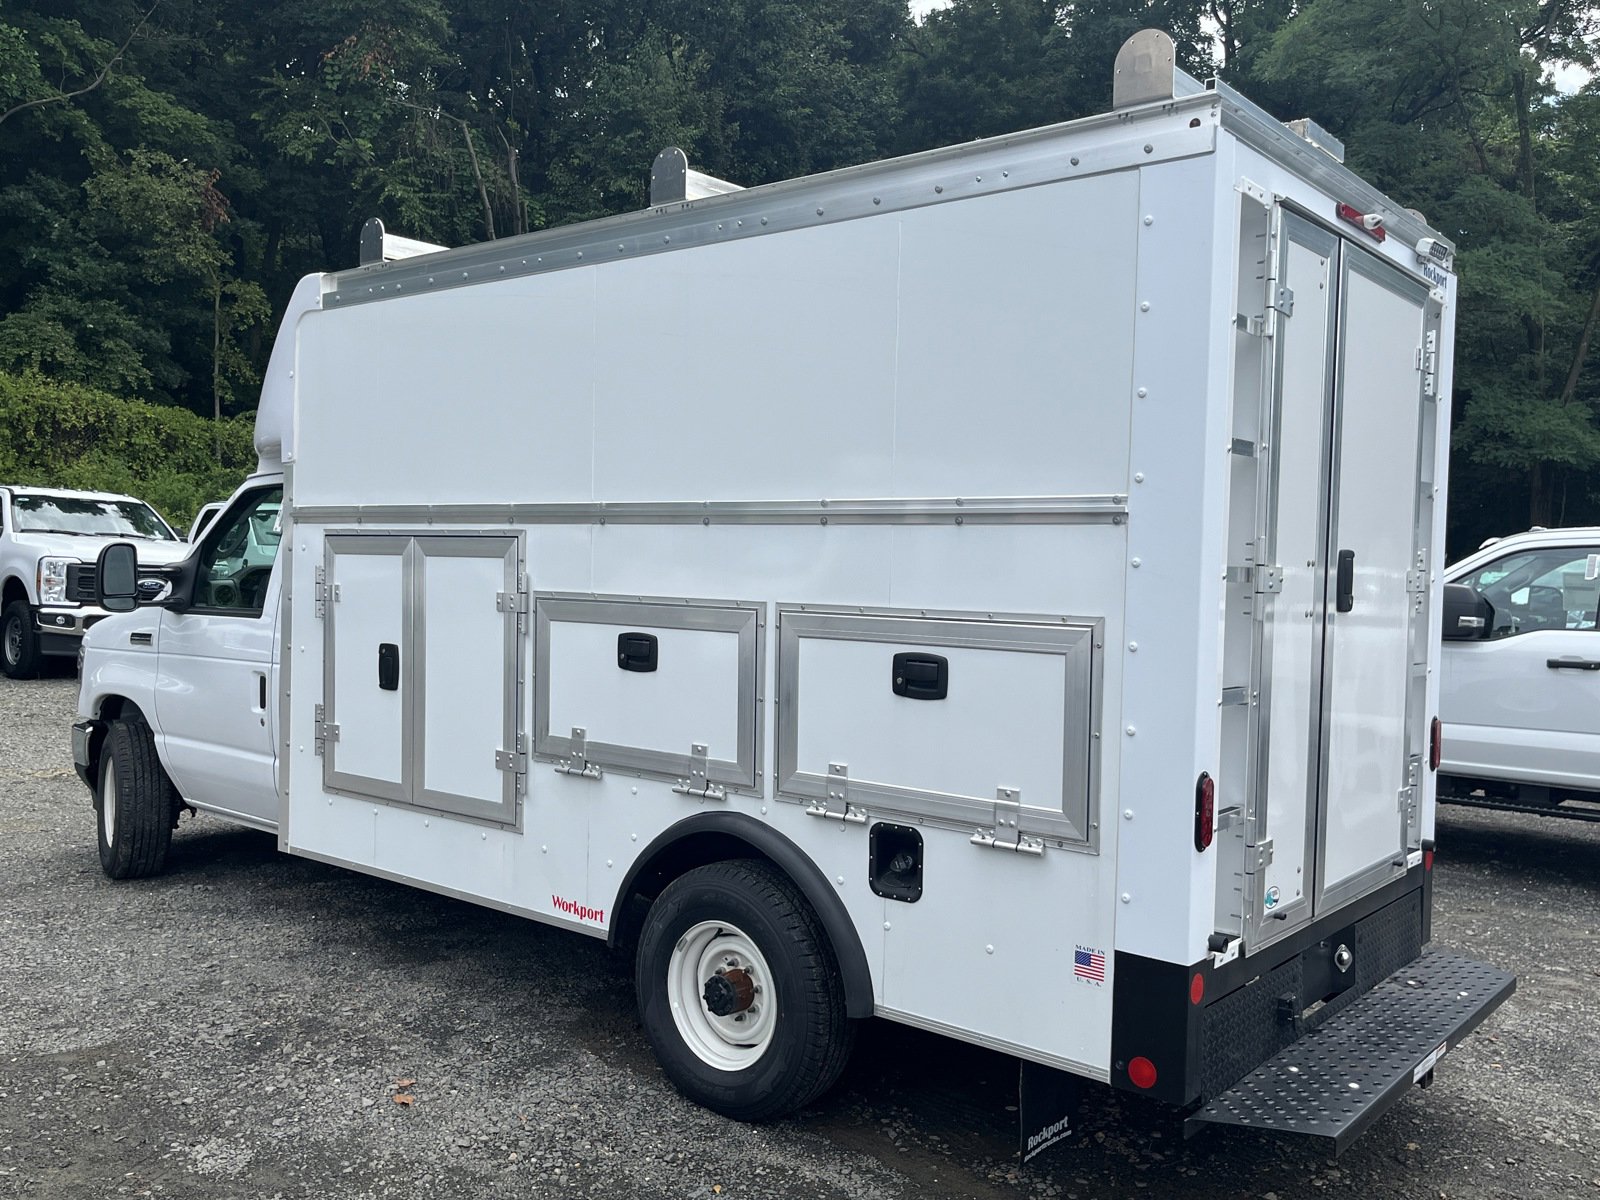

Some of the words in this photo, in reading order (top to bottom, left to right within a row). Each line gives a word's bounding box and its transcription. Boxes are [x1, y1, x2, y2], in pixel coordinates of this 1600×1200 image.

[1423, 262, 1447, 289] Rockport
[551, 894, 604, 923] Workport
[1074, 944, 1095, 953] MADE
[1027, 1115, 1069, 1151] Rockport
